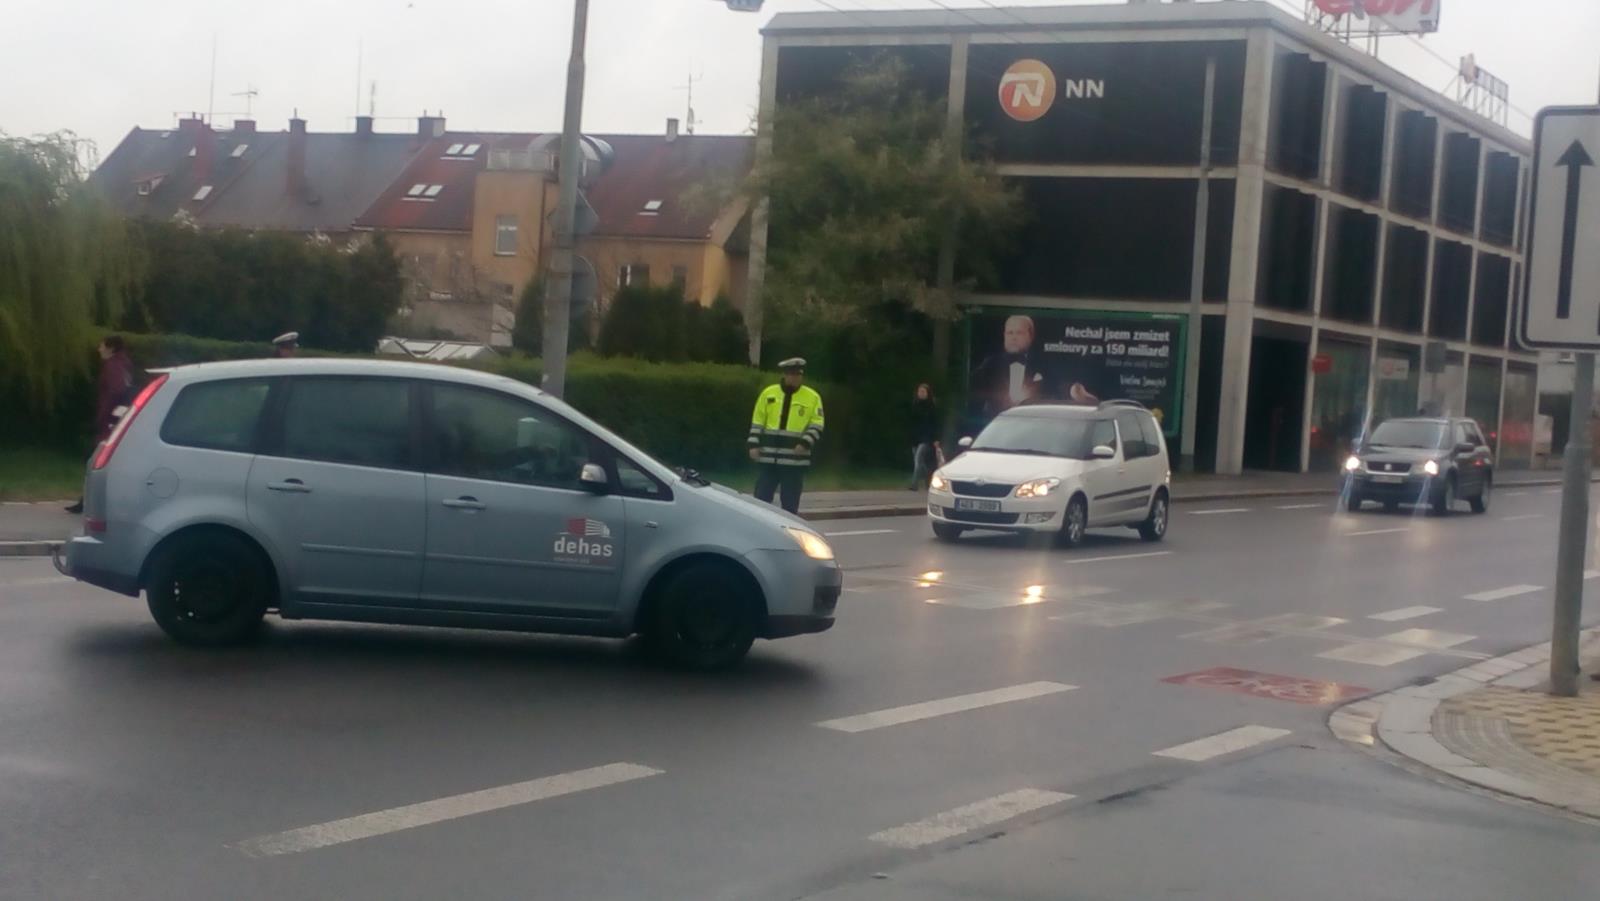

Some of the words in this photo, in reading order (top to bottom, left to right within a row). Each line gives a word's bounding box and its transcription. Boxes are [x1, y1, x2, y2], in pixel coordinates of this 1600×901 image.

[1065, 78, 1105, 99] NN
[1065, 326, 1103, 339] Nechal
[1104, 328, 1131, 341] jsem
[1132, 330, 1170, 341] zmizet
[1043, 341, 1088, 356] smlouvy
[1090, 345, 1103, 354] za
[1106, 343, 1126, 355] 150
[553, 536, 613, 557] dehas
